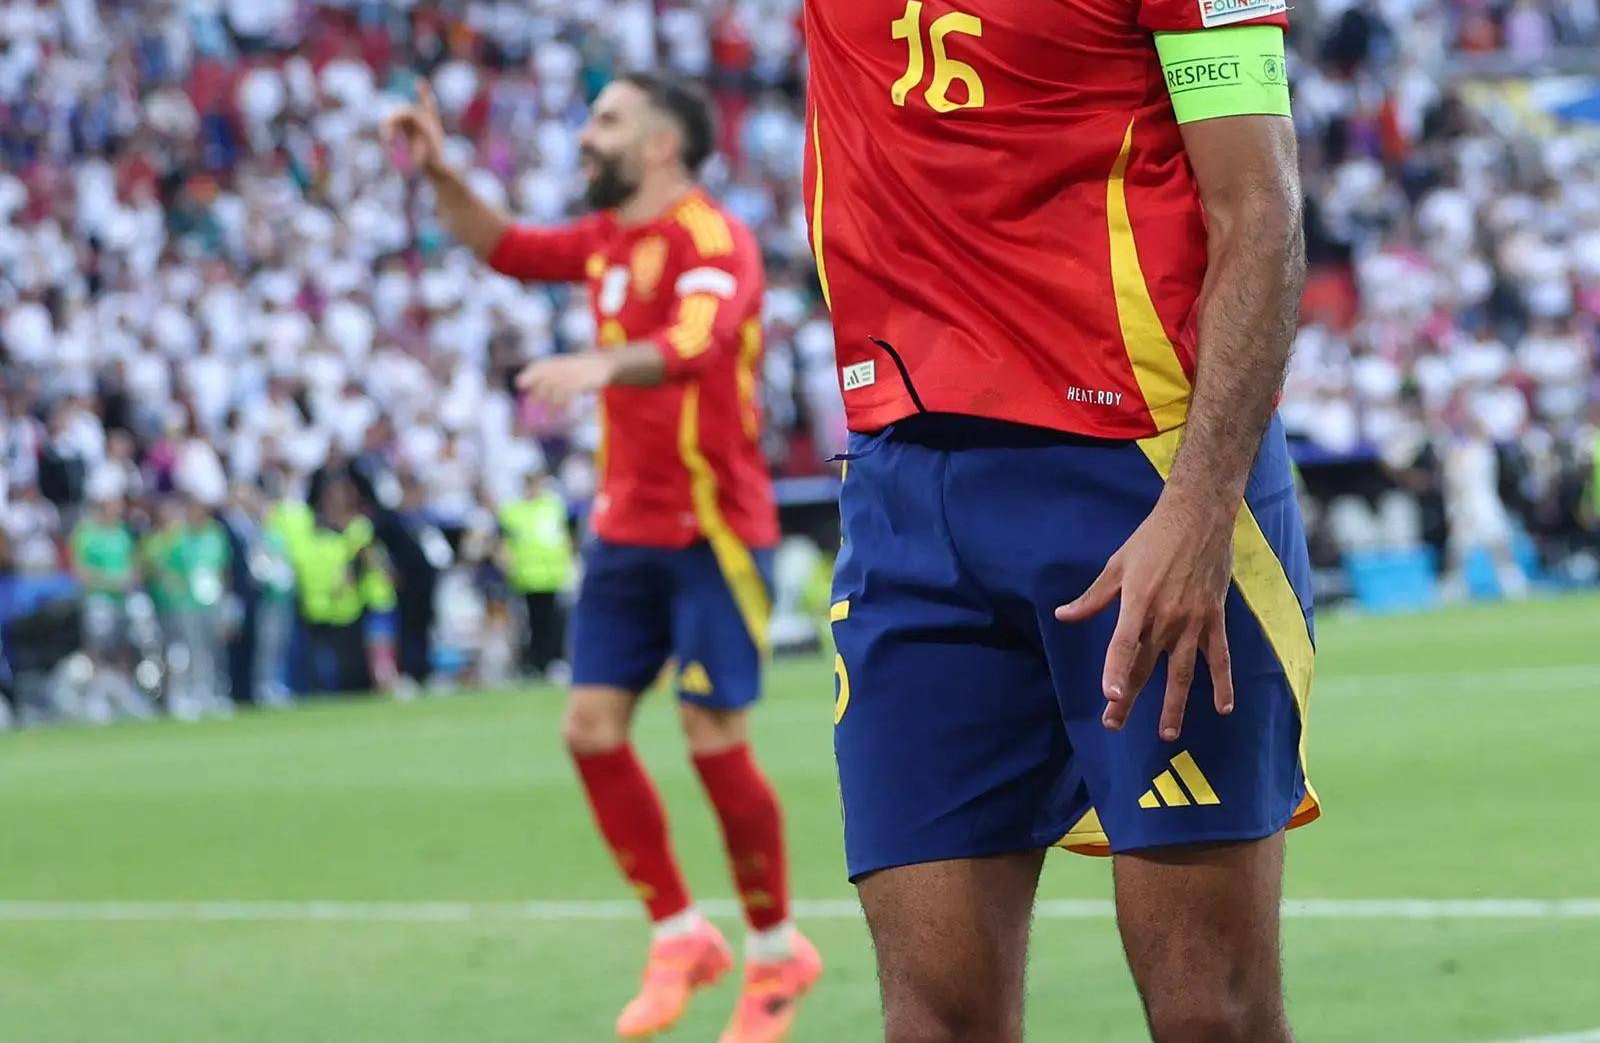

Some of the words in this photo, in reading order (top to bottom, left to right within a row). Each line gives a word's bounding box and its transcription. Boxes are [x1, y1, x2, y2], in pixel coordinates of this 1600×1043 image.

[891, 0, 985, 113] 16
[1167, 62, 1240, 88] RESPECT
[1067, 386, 1122, 406] HEAT.RDY
